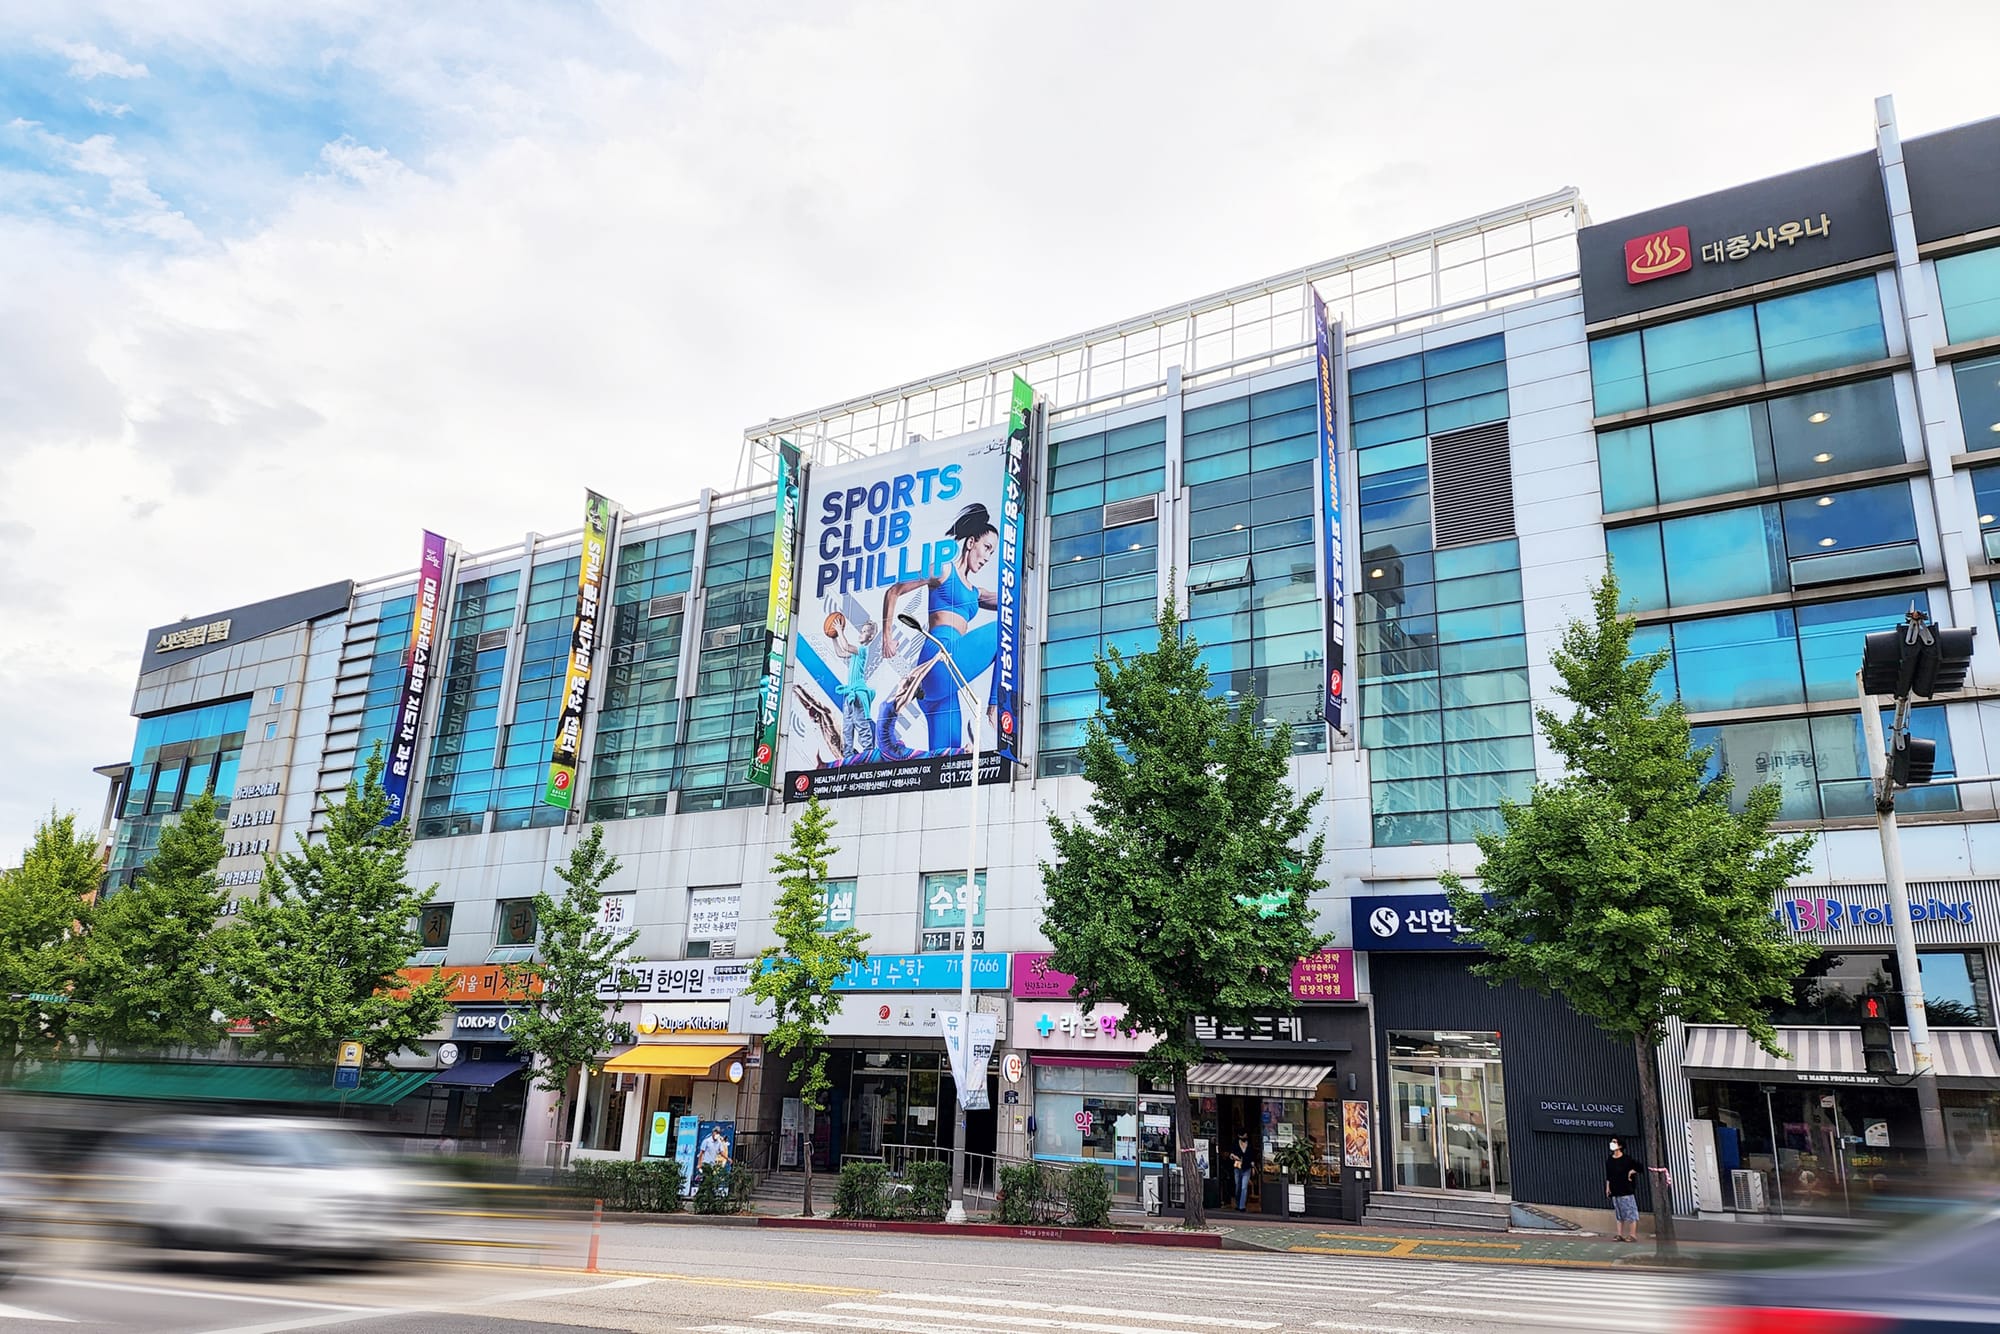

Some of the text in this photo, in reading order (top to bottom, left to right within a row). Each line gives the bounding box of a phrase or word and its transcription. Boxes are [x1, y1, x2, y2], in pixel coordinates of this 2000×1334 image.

[1702, 213, 1831, 263] 대중사우나
[820, 464, 963, 526] SPORTS
[819, 510, 912, 562] CLUB
[585, 540, 601, 583] SFM
[816, 538, 961, 599] PHILLIP
[581, 584, 598, 619] 골프
[573, 620, 594, 673] 비거리
[567, 676, 586, 713] 향상
[400, 695, 421, 741] 지도자
[560, 716, 579, 753] 센터
[392, 744, 412, 777] 과정
[814, 774, 836, 783] HEALTH
[850, 771, 873, 780] PILATES
[877, 769, 893, 778] SWIM
[941, 760, 973, 770] 스포츠클럽필
[428, 910, 529, 938] 치 과
[657, 968, 704, 994] 한의원
[946, 957, 999, 974] 7117666
[1314, 973, 1340, 984] 김하정
[1299, 984, 1341, 996] 원장직영점
[1010, 1058, 1021, 1080] 약
[1074, 1110, 1094, 1137] 약
[1541, 1101, 1624, 1113] DIGITAL LOUNGE
